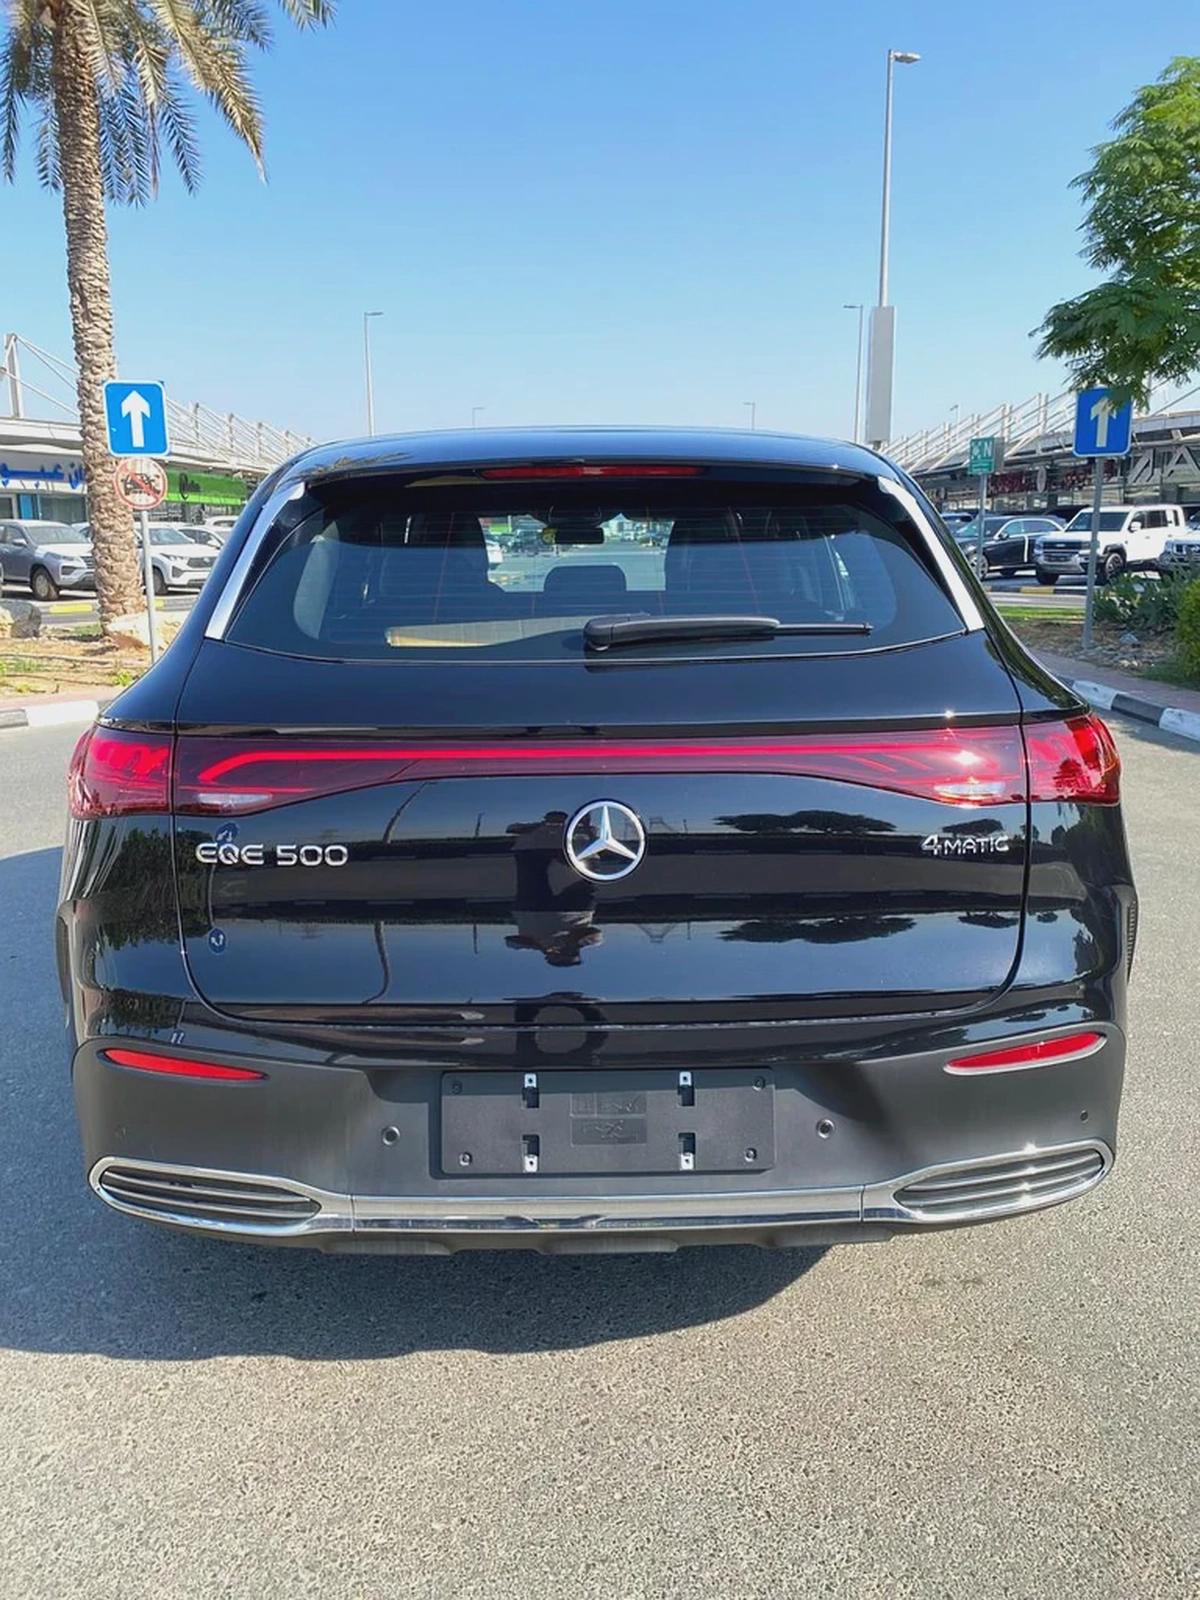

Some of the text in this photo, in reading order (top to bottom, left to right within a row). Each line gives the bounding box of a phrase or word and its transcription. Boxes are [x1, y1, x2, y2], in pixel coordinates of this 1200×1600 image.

[195, 842, 349, 866] EQE 500
[920, 834, 1010, 855] 4MATIC
